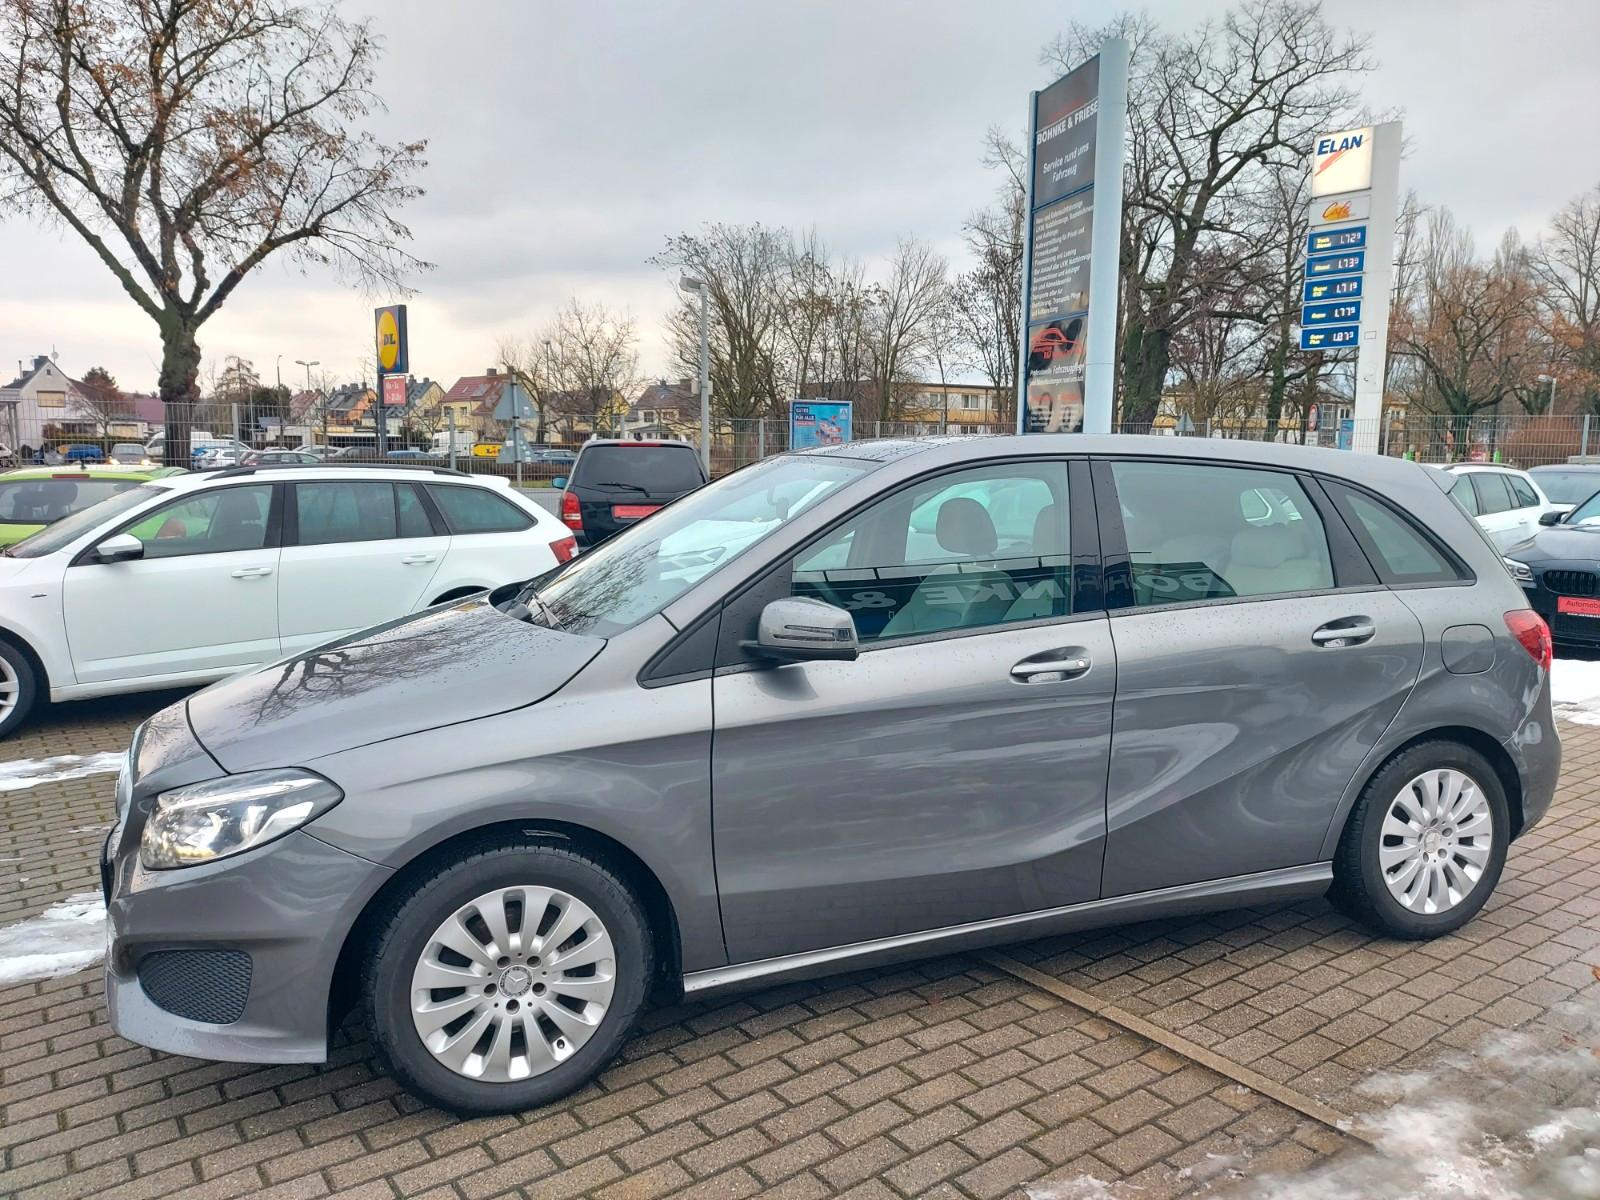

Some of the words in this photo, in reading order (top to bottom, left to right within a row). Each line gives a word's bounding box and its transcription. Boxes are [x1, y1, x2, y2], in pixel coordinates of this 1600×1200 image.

[1037, 120, 1066, 145] BOHNKE
[1067, 116, 1073, 129] &
[1074, 101, 1098, 126] FRIESE
[1043, 156, 1063, 174] Service
[1064, 146, 1077, 164] rund
[1077, 142, 1089, 156] ums
[1317, 135, 1363, 155] ELAN
[1052, 164, 1077, 183] Fahrzeug
